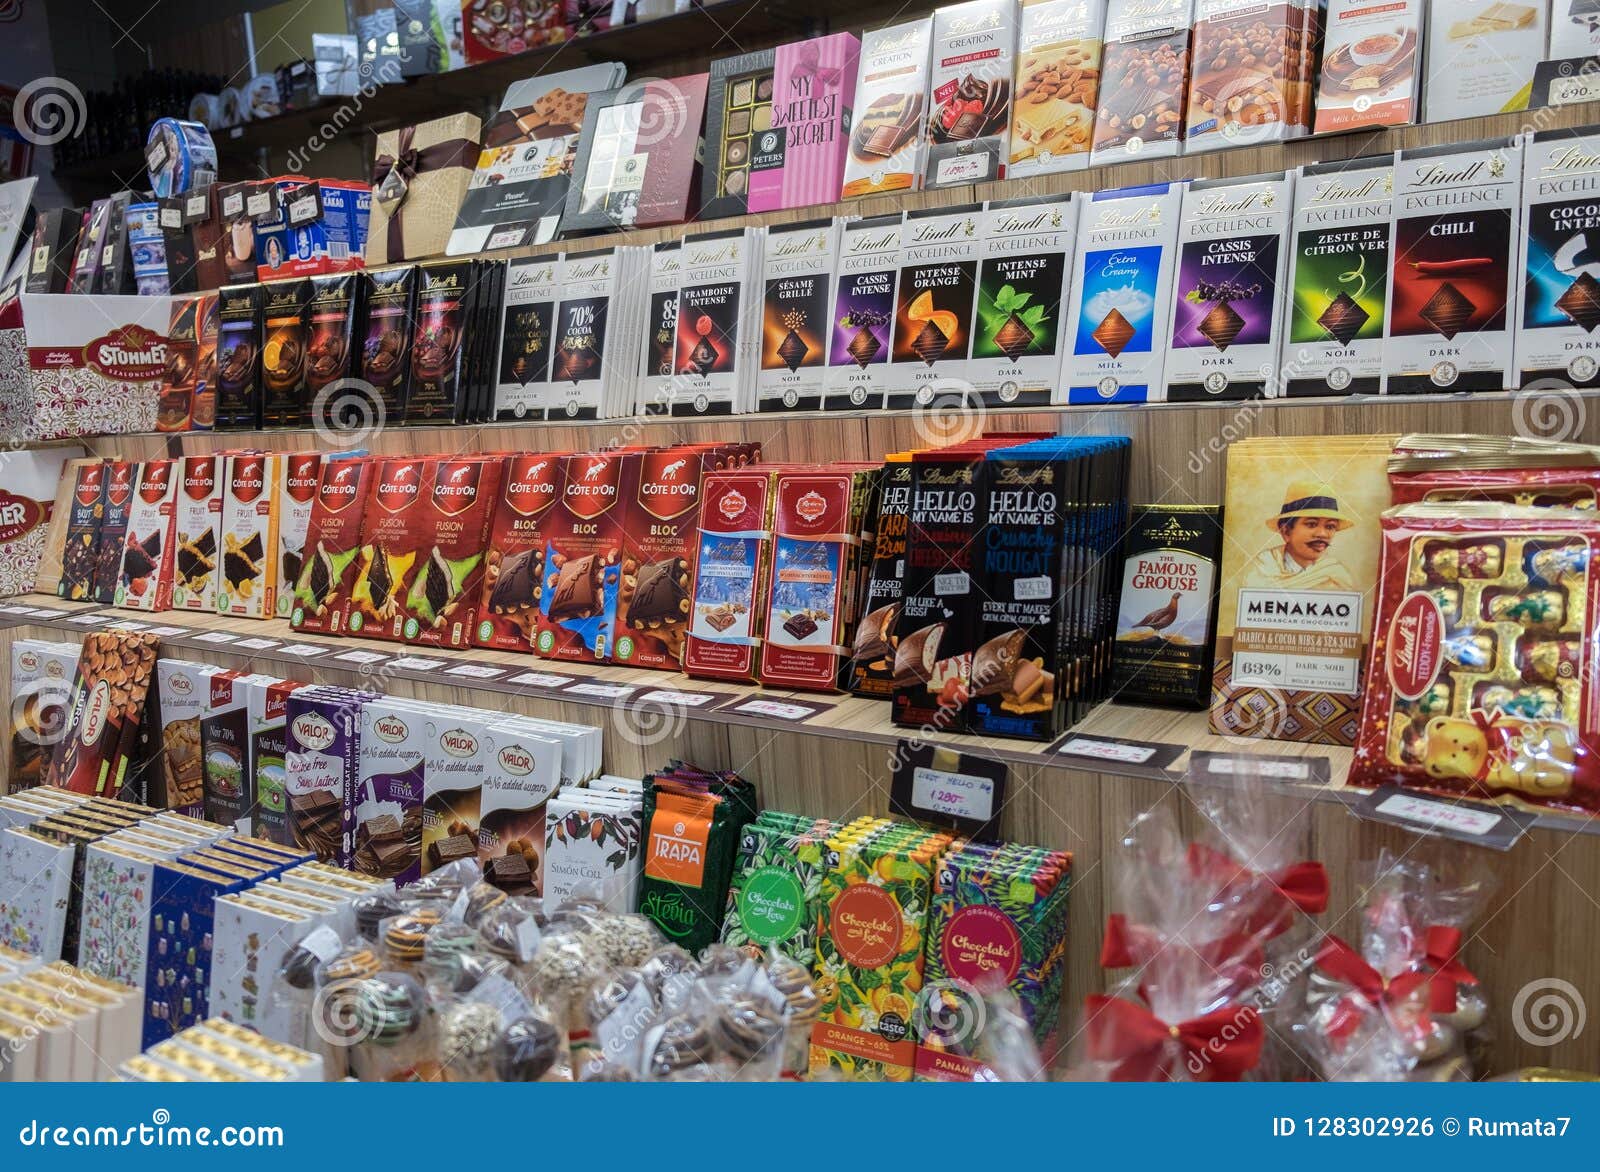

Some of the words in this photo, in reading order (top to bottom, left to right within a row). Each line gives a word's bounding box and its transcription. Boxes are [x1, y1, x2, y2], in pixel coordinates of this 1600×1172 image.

[949, 34, 994, 49] CREATION
[872, 52, 912, 67] CREATION
[790, 77, 812, 97] MY
[939, 86, 955, 98] NEU
[772, 93, 838, 127] SWEETEST
[1351, 109, 1392, 121] Chocolate
[788, 118, 837, 148] SECRET
[753, 153, 783, 165] PETERS
[508, 163, 543, 175] PETERS
[1408, 160, 1485, 186] Lindt
[1310, 177, 1380, 201] Lindt
[1193, 193, 1258, 216] Lindt
[1406, 188, 1503, 210] EXCELLENCE
[993, 211, 1048, 233] Lindt
[1191, 217, 1273, 236] EXCELLENCE
[1430, 221, 1475, 237] CHILI
[912, 222, 962, 242] Lindt
[1092, 228, 1158, 244] EXCELLENCE
[1318, 231, 1359, 244] ZESTE
[1363, 230, 1381, 240] DE
[774, 237, 815, 256] Lindt
[850, 231, 895, 252] Lindt
[988, 235, 1059, 252] EXCELLENCE
[1208, 240, 1251, 254] CASSIS
[907, 246, 972, 260] EXCELLENCE
[1304, 243, 1355, 256] CITRON
[688, 250, 726, 266] Lindt
[1108, 251, 1137, 265] Extra
[1201, 251, 1256, 266] INTENSE
[567, 263, 599, 280] Lindt
[770, 258, 824, 273] EXCELLENCE
[997, 259, 1048, 272] INTENSE
[1101, 265, 1140, 279] Creamy
[512, 270, 543, 287] Lindt
[856, 274, 888, 285] CASSIS
[914, 267, 961, 279] INTENSE
[1005, 269, 1038, 281] MINT
[778, 279, 814, 291] SÉSAME
[852, 283, 891, 296] INTENSE
[914, 277, 960, 288] ORANGE
[685, 286, 734, 299] FRAMBOISE
[690, 295, 727, 306] INTENSE
[569, 304, 595, 328] 70%
[567, 326, 592, 335] COCOA
[1325, 350, 1356, 358] NOIR
[1429, 348, 1460, 357] DARK
[1202, 358, 1234, 366] DARK
[322, 484, 338, 494] CÔTE
[339, 485, 356, 495] D'OR
[380, 483, 398, 493] CÔTE
[399, 484, 417, 494] D'OR
[435, 484, 455, 495] CÔTE
[456, 485, 475, 496] D'OR
[509, 482, 531, 493] CÔTE
[533, 483, 553, 494] D'OR
[567, 483, 590, 496] CÔTE
[592, 484, 615, 497] D'OR
[642, 482, 668, 495] CÔTE
[671, 482, 695, 496] D'OR
[913, 491, 976, 512] HELLO
[988, 491, 1057, 513] HELLO
[189, 507, 205, 516] FRUIT
[237, 509, 253, 518] FRUIT
[292, 508, 310, 518] FRUIT
[913, 512, 927, 523] MY
[928, 512, 960, 523] NAME
[962, 513, 974, 524] IS
[321, 518, 344, 528] FUSION
[379, 518, 405, 528] FUSION
[436, 521, 464, 531] FUSION
[513, 519, 537, 530] BLOC
[988, 513, 1005, 525] MY
[1006, 513, 1040, 525] NAME
[1043, 514, 1055, 526] IS
[573, 524, 597, 534] BLOC
[650, 525, 677, 536] BLOC
[643, 537, 657, 545] NOIR
[658, 537, 684, 545] NOISETTES
[986, 527, 1055, 549] Crunchy
[985, 551, 1051, 573] NOUGAT
[1137, 560, 1197, 577] FAMOUS
[1132, 574, 1198, 592] GROUSE
[917, 598, 936, 607] LIKE
[983, 601, 1006, 612] EVERY
[1022, 603, 1051, 614] MAKES
[1248, 600, 1350, 617] MENAKAO
[905, 606, 928, 617] KISS!
[1237, 632, 1266, 643] ARABICA
[1274, 634, 1296, 645] COCOA
[1298, 635, 1315, 646] NIBS
[1323, 636, 1337, 647] SEA
[1338, 637, 1357, 649] SALT
[1417, 610, 1436, 680] TEDDY-Freunde
[1394, 626, 1415, 673] Lindt
[1241, 661, 1282, 676] 63%
[1295, 662, 1317, 670] DARK
[1325, 663, 1344, 672] NOIR
[170, 679, 190, 689] VALOR
[72, 689, 86, 726] PURO
[84, 686, 106, 738] VALOR
[298, 721, 330, 741] VALOR
[378, 722, 405, 738] VALOR
[443, 736, 473, 751] VALOR
[345, 759, 351, 768] AU
[500, 752, 531, 770] VALOR
[389, 786, 413, 797] STEVIA
[502, 779, 523, 791] added
[524, 782, 547, 796] sugars
[423, 815, 443, 827] STEVIA
[479, 834, 500, 848] STEVIA
[654, 834, 703, 865] TRAPA
[551, 861, 578, 877] SIMÓN
[580, 865, 602, 879] COLL
[553, 886, 569, 896] 70%
[853, 887, 884, 899] ORGANIC
[748, 891, 795, 912] Chocolate
[640, 891, 697, 928] Stevia
[766, 907, 785, 923] Love
[966, 907, 1001, 921] ORGANIC
[840, 912, 894, 933] Chocolate
[863, 930, 884, 946] Love
[952, 934, 1010, 958] Chocolate
[959, 950, 976, 963] and
[975, 953, 1000, 971] Love
[879, 1020, 906, 1035] taste
[827, 1029, 866, 1045] ORANGE
